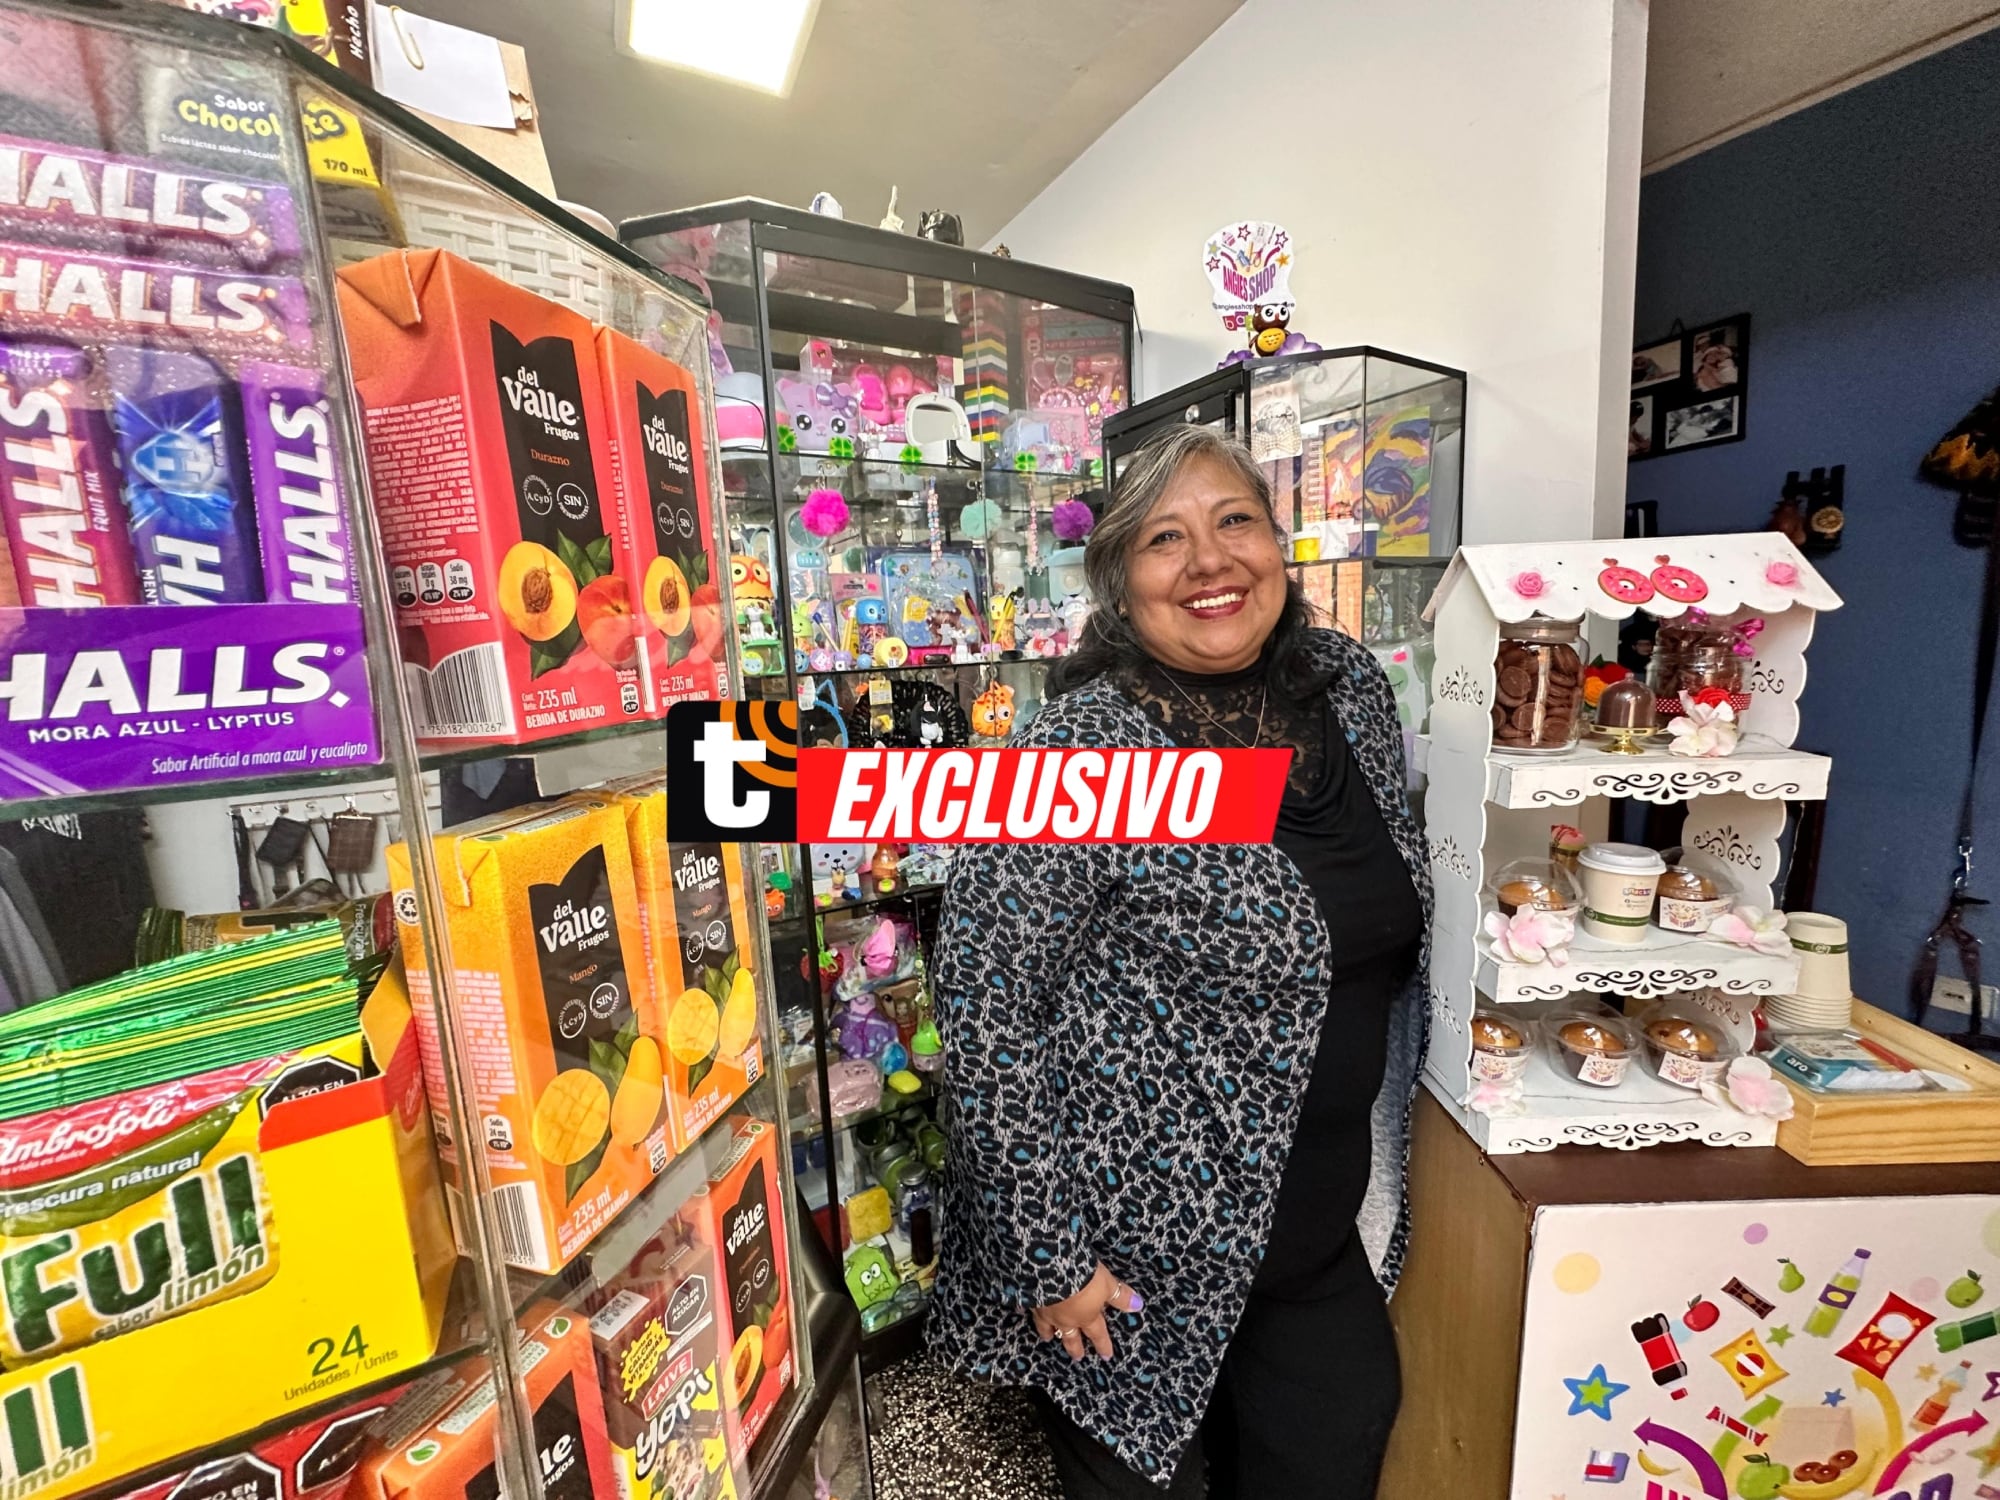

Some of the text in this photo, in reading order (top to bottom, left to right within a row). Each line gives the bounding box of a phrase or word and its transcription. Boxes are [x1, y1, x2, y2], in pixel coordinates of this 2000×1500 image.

[341, 5, 364, 60] Hecho
[214, 95, 267, 112] Sabor
[322, 158, 369, 177] 170 ml
[1223, 263, 1276, 302] ANGIES SHOP
[518, 366, 539, 388] del
[501, 376, 578, 427] Valle
[543, 422, 580, 441] Frugos
[652, 415, 666, 432] del
[530, 449, 570, 466] Durazno
[642, 423, 689, 462] Valle
[668, 459, 689, 474] Frugos
[83, 471, 111, 533] FRUIT MIX
[269, 401, 347, 604] HALLS
[563, 494, 582, 506] SIN
[537, 690, 560, 710] 235
[561, 687, 578, 707] ml
[671, 676, 685, 692] 235
[684, 675, 694, 690] ml
[27, 725, 111, 744] MORA
[119, 719, 186, 738] AZUL
[207, 711, 295, 732] LYPTUS
[526, 705, 606, 729] BEBIDA DE DURAZNO
[151, 742, 369, 775] Sabor Artificial a mora azul y eucalipto
[682, 848, 696, 866] del
[674, 856, 719, 892] Valle
[698, 877, 721, 893] Frugos
[553, 899, 573, 921] del
[540, 905, 607, 953] Valle
[577, 929, 610, 952] Frugos
[709, 928, 722, 942] SIN
[569, 964, 598, 985] Mango
[596, 991, 613, 1009] SIN
[1786, 1055, 1808, 1072] aro
[111, 1151, 200, 1190] natural
[572, 1198, 596, 1230] 235
[596, 1184, 612, 1209] ml
[603, 1189, 630, 1220] MANGO
[725, 1202, 764, 1256] Valle
[0, 1153, 262, 1354] Full
[94, 1243, 265, 1339] sabor limón
[671, 1284, 699, 1317] ALTO EN
[307, 1323, 370, 1378] 24
[283, 1368, 352, 1401] Unidades
[363, 1349, 399, 1371] Units
[647, 1356, 689, 1409] LAIVE
